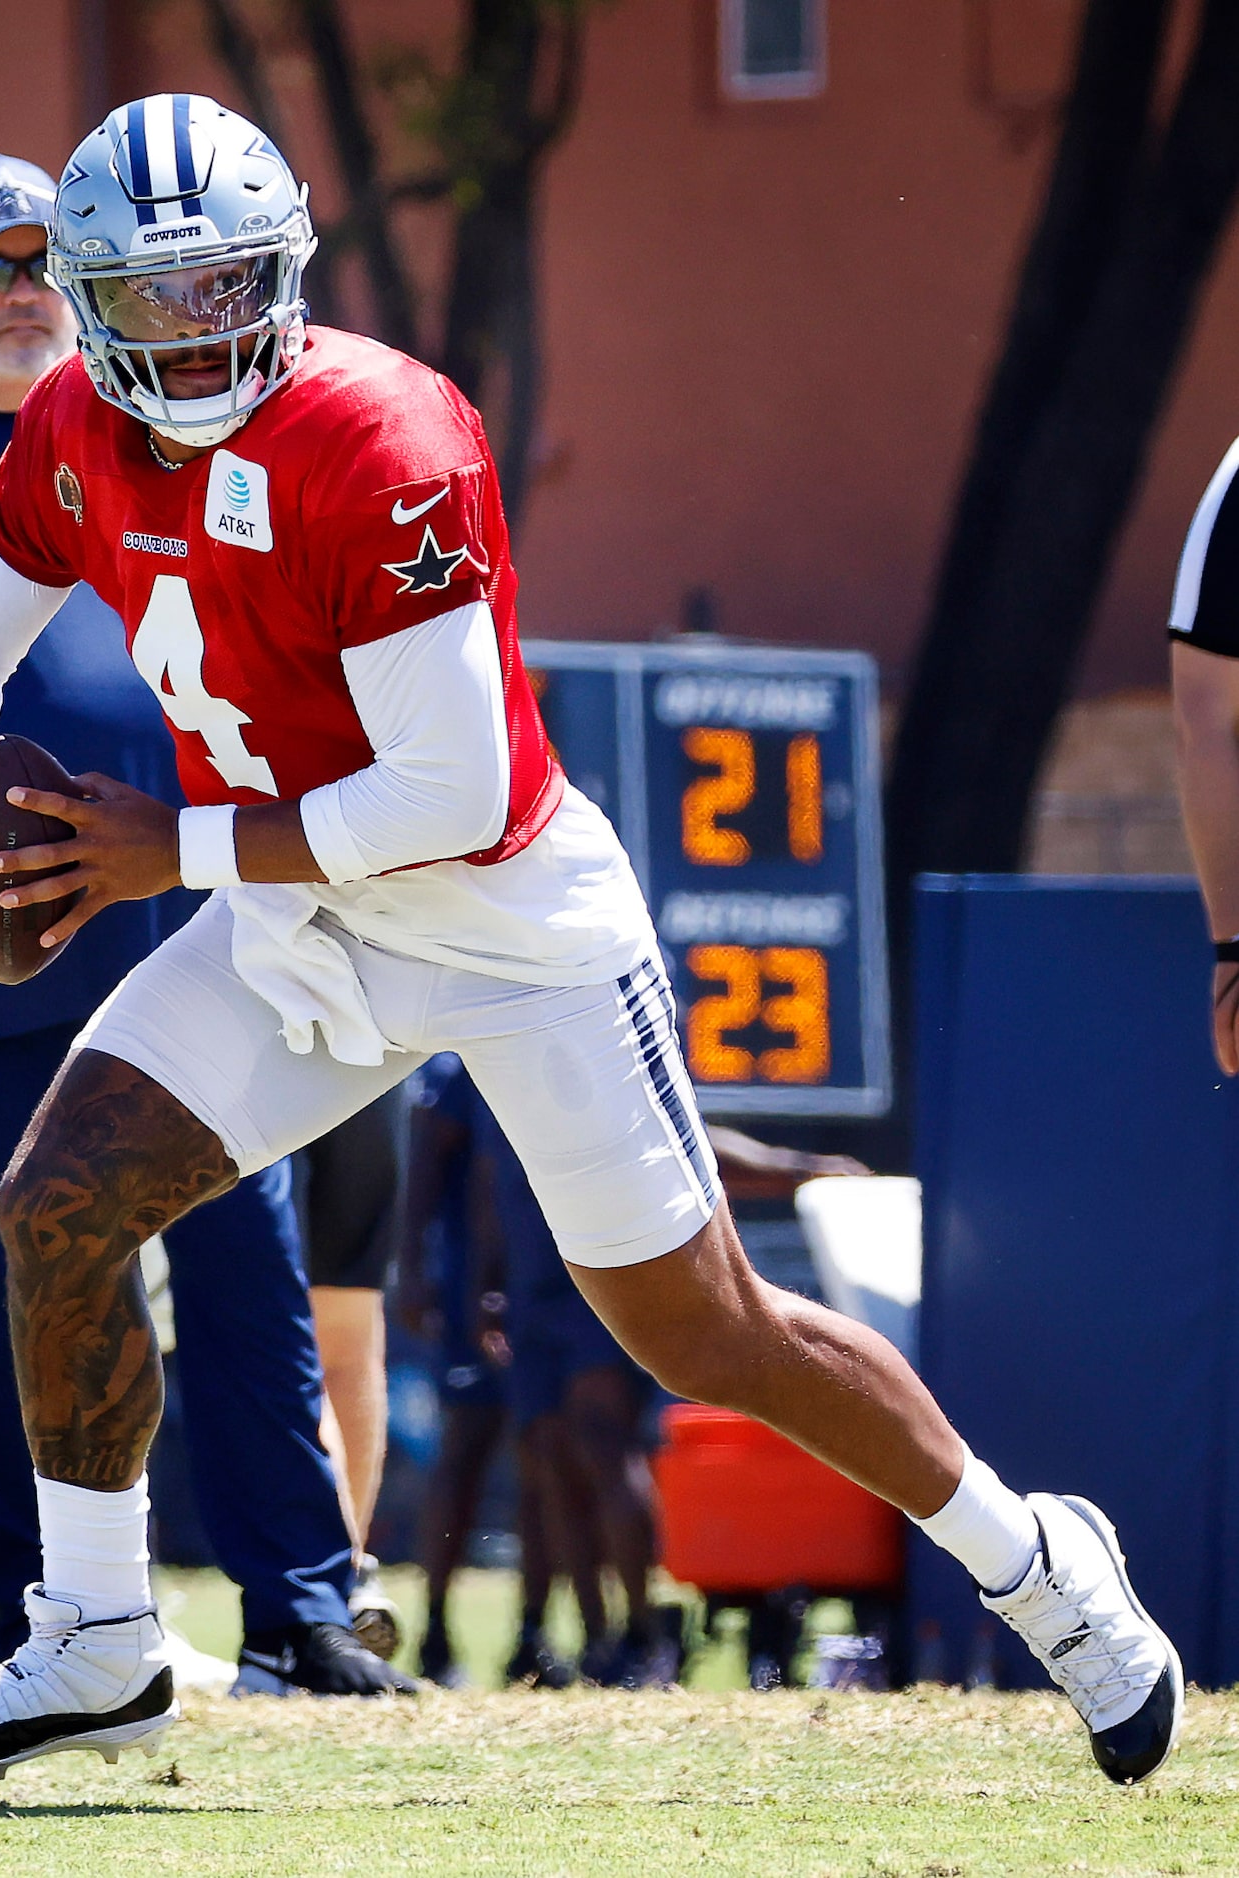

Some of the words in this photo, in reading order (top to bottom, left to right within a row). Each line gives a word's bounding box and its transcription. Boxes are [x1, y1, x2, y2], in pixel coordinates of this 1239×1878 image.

[143, 226, 202, 243] COWBOYS
[123, 532, 188, 557] COWBOYS
[218, 513, 255, 538] AT&T
[131, 574, 280, 798] 4
[681, 726, 824, 867] 21
[686, 944, 831, 1084] 23
